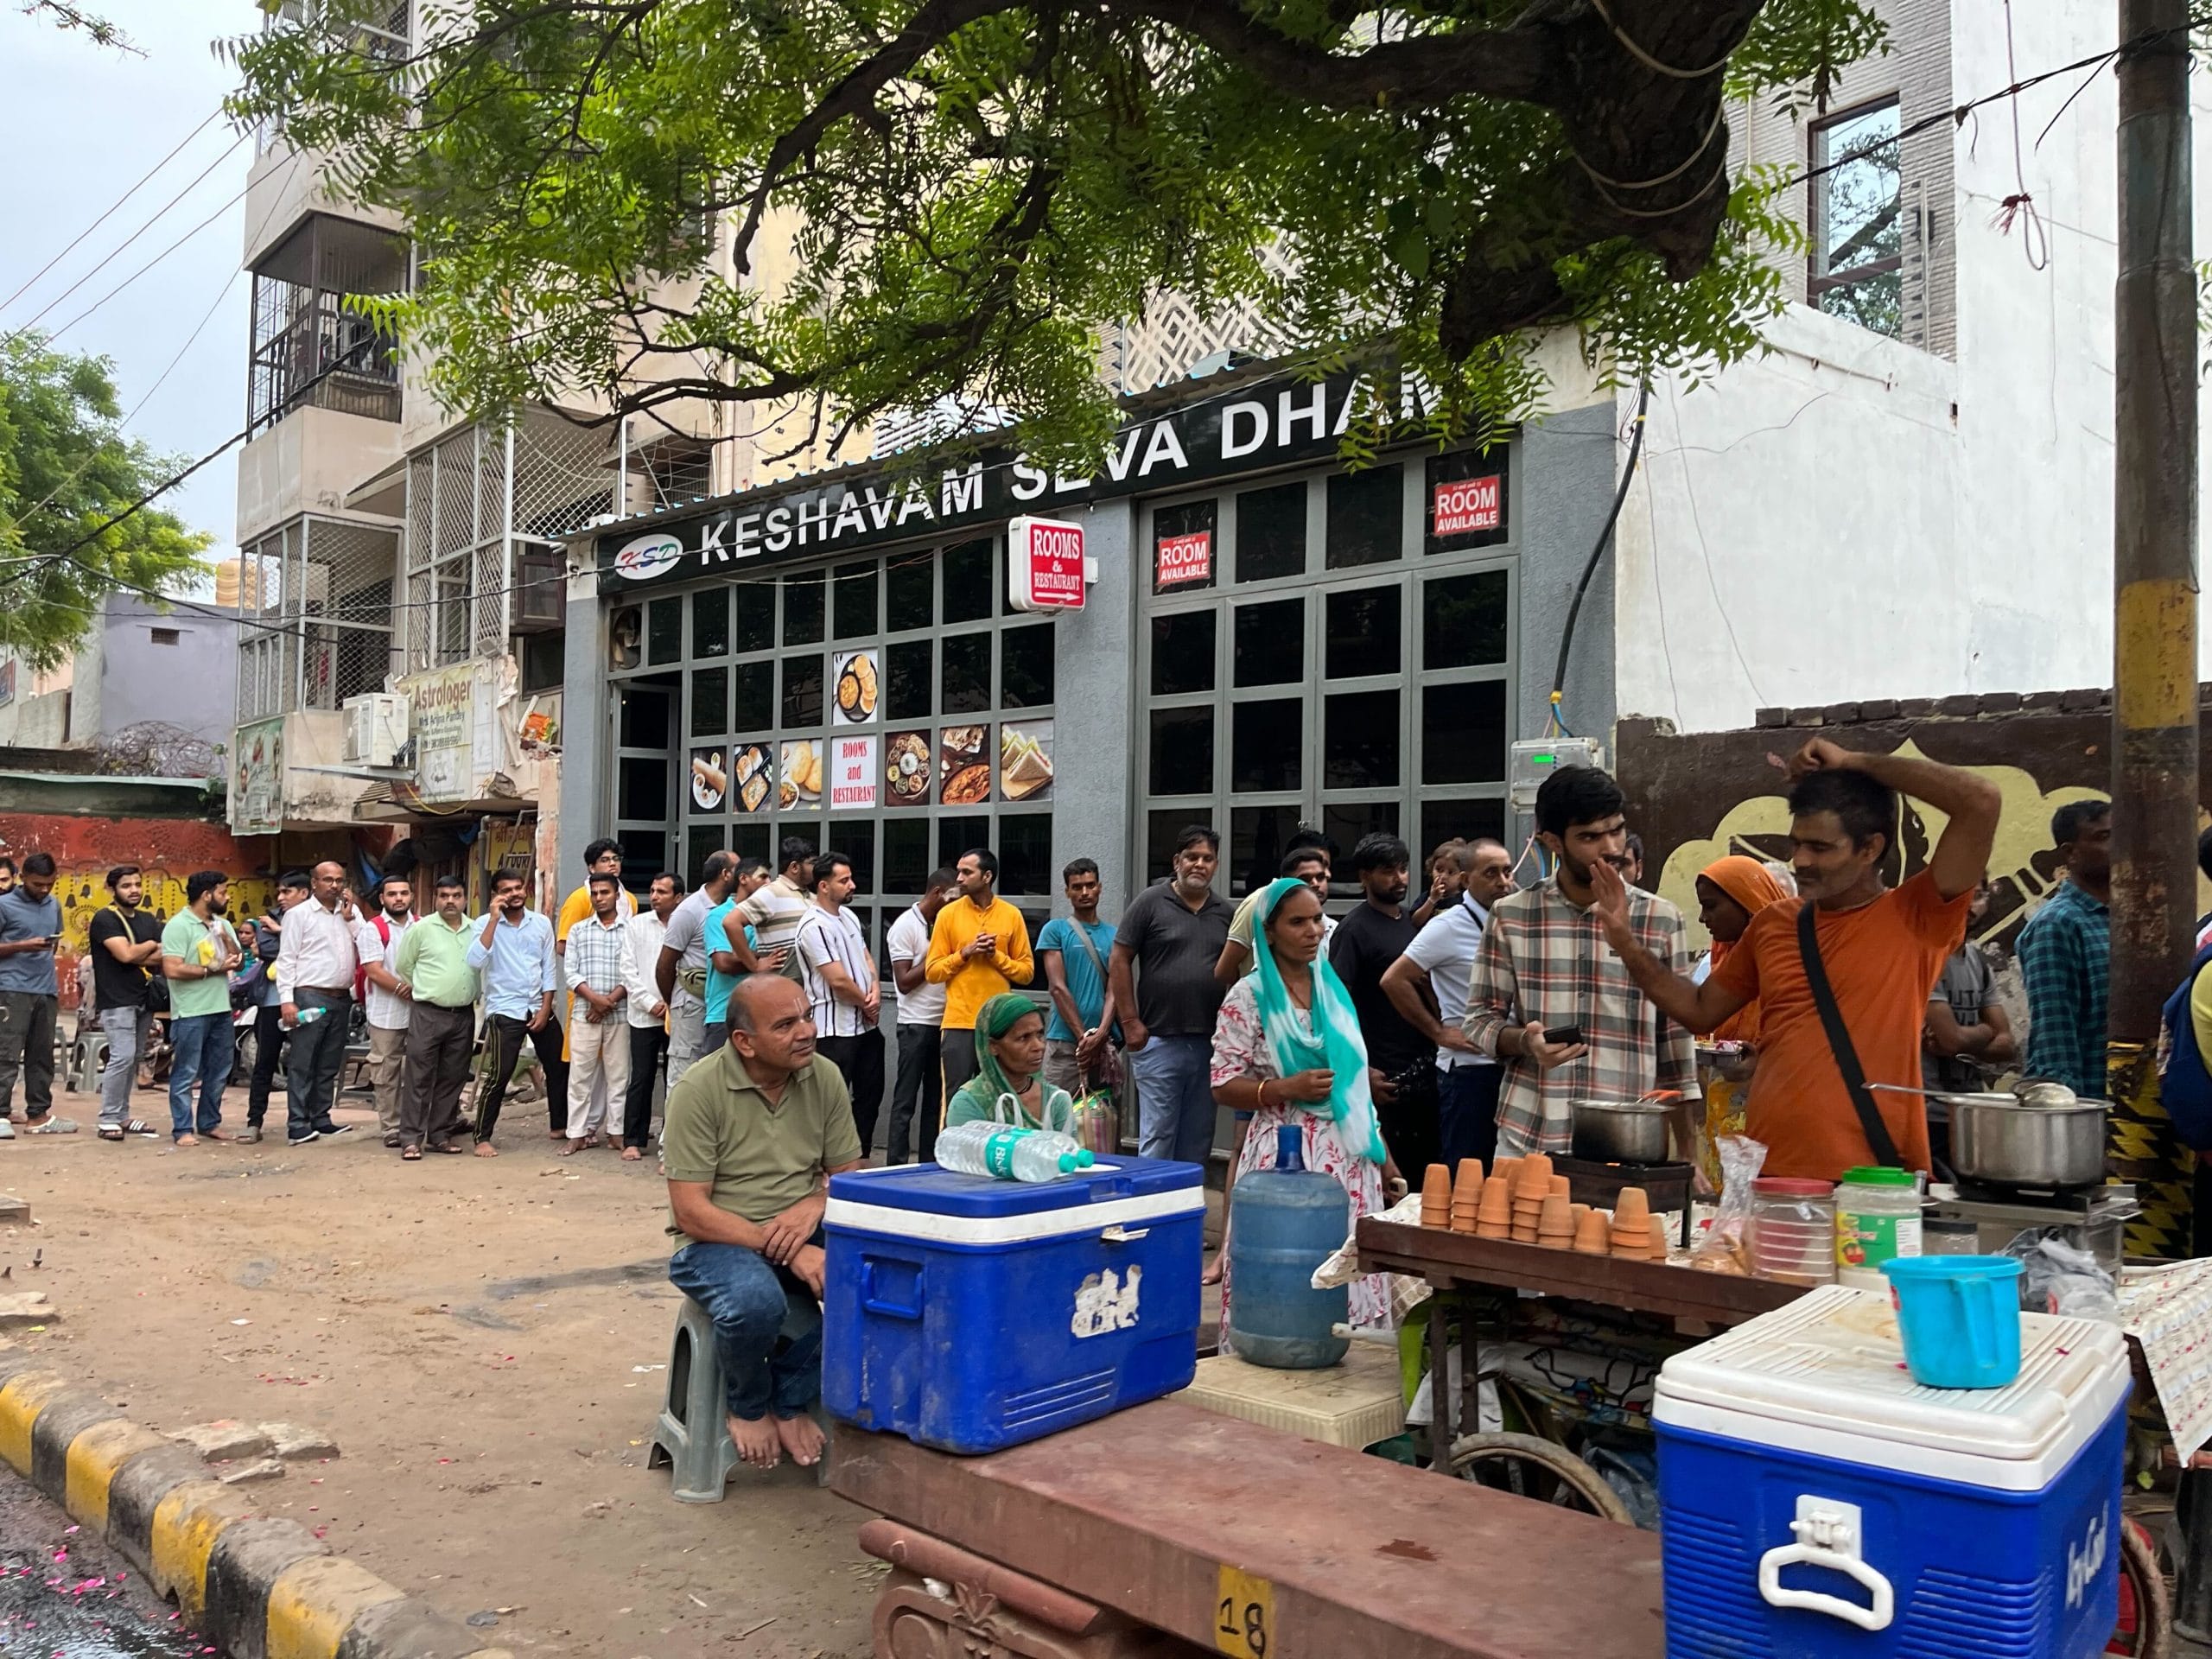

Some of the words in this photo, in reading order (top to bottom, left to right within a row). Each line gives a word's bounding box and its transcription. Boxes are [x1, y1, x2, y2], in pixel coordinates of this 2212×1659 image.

[1437, 484, 1496, 516] ROOM
[702, 461, 983, 566] KESHAVAM
[1436, 510, 1497, 533] AVAILABLE
[1033, 529, 1080, 560] ROOMS
[1161, 541, 1207, 567] ROOM
[1052, 560, 1063, 573] &
[1160, 563, 1208, 582] AVAILABLE
[1034, 572, 1080, 591] RESTAURANT
[415, 678, 472, 710] Astrologer
[842, 741, 868, 759] ROOMS
[847, 764, 861, 780] and
[832, 785, 877, 804] RESTAURANT
[1219, 1597, 1267, 1659] 18
